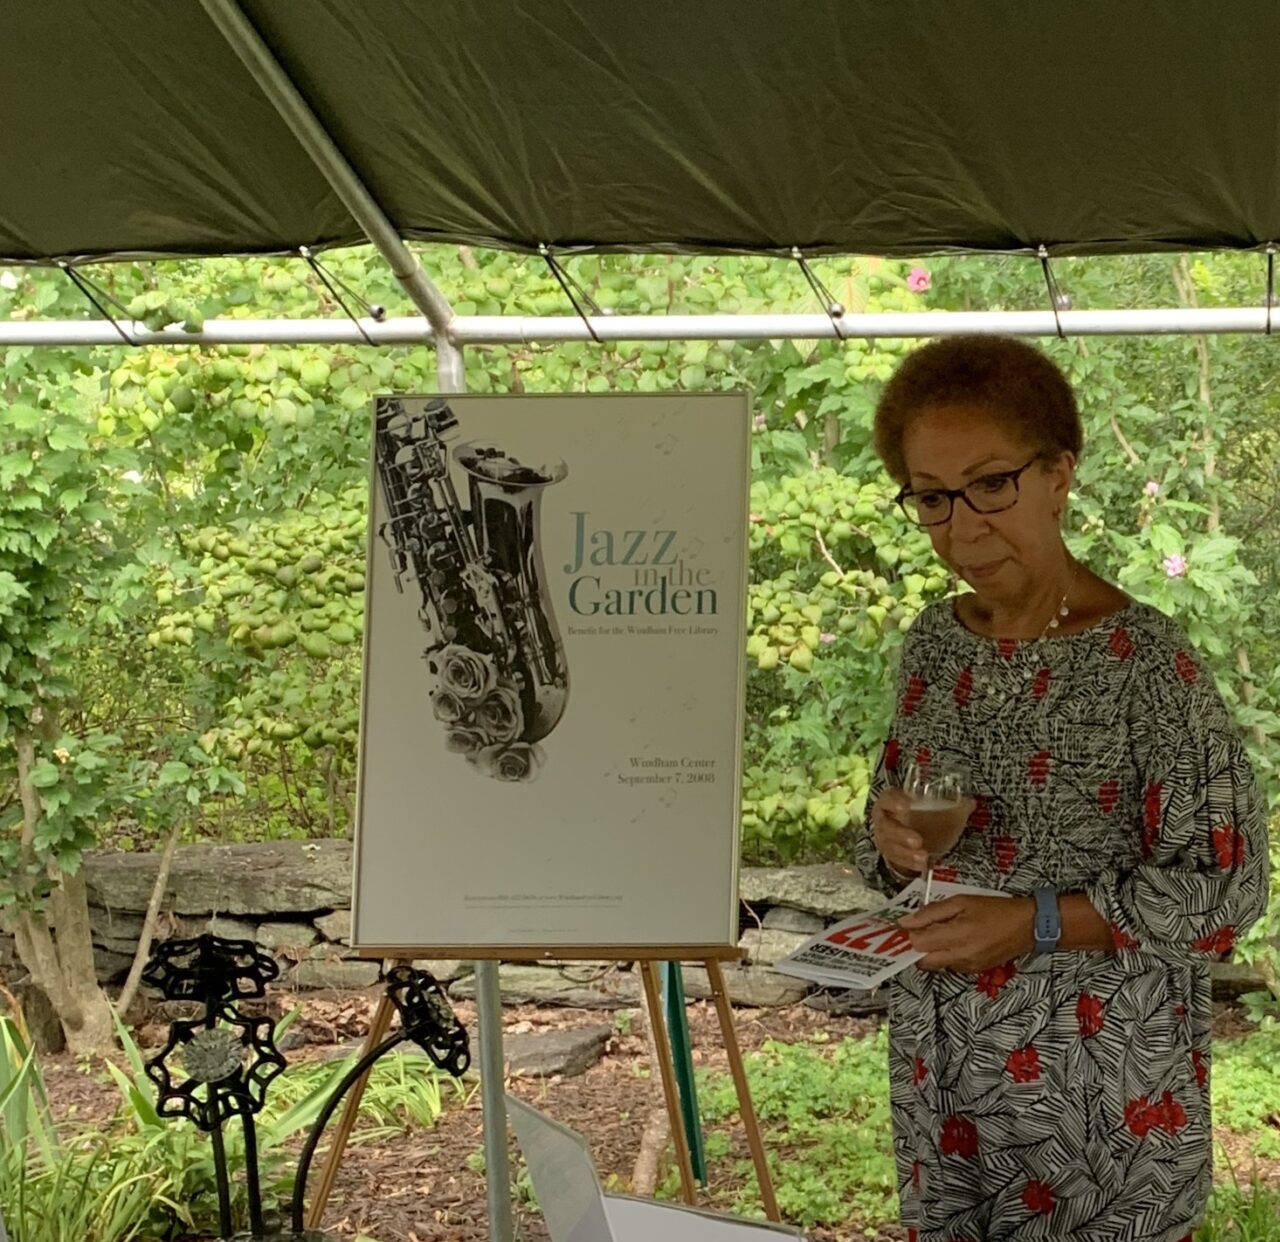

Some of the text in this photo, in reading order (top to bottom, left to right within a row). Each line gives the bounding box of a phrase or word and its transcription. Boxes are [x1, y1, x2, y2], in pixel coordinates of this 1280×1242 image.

[563, 511, 680, 574] Jazz
[634, 559, 716, 587] in the
[568, 575, 719, 617] Garden
[629, 757, 716, 768] Windham Center
[618, 772, 716, 787] September 7, 2008
